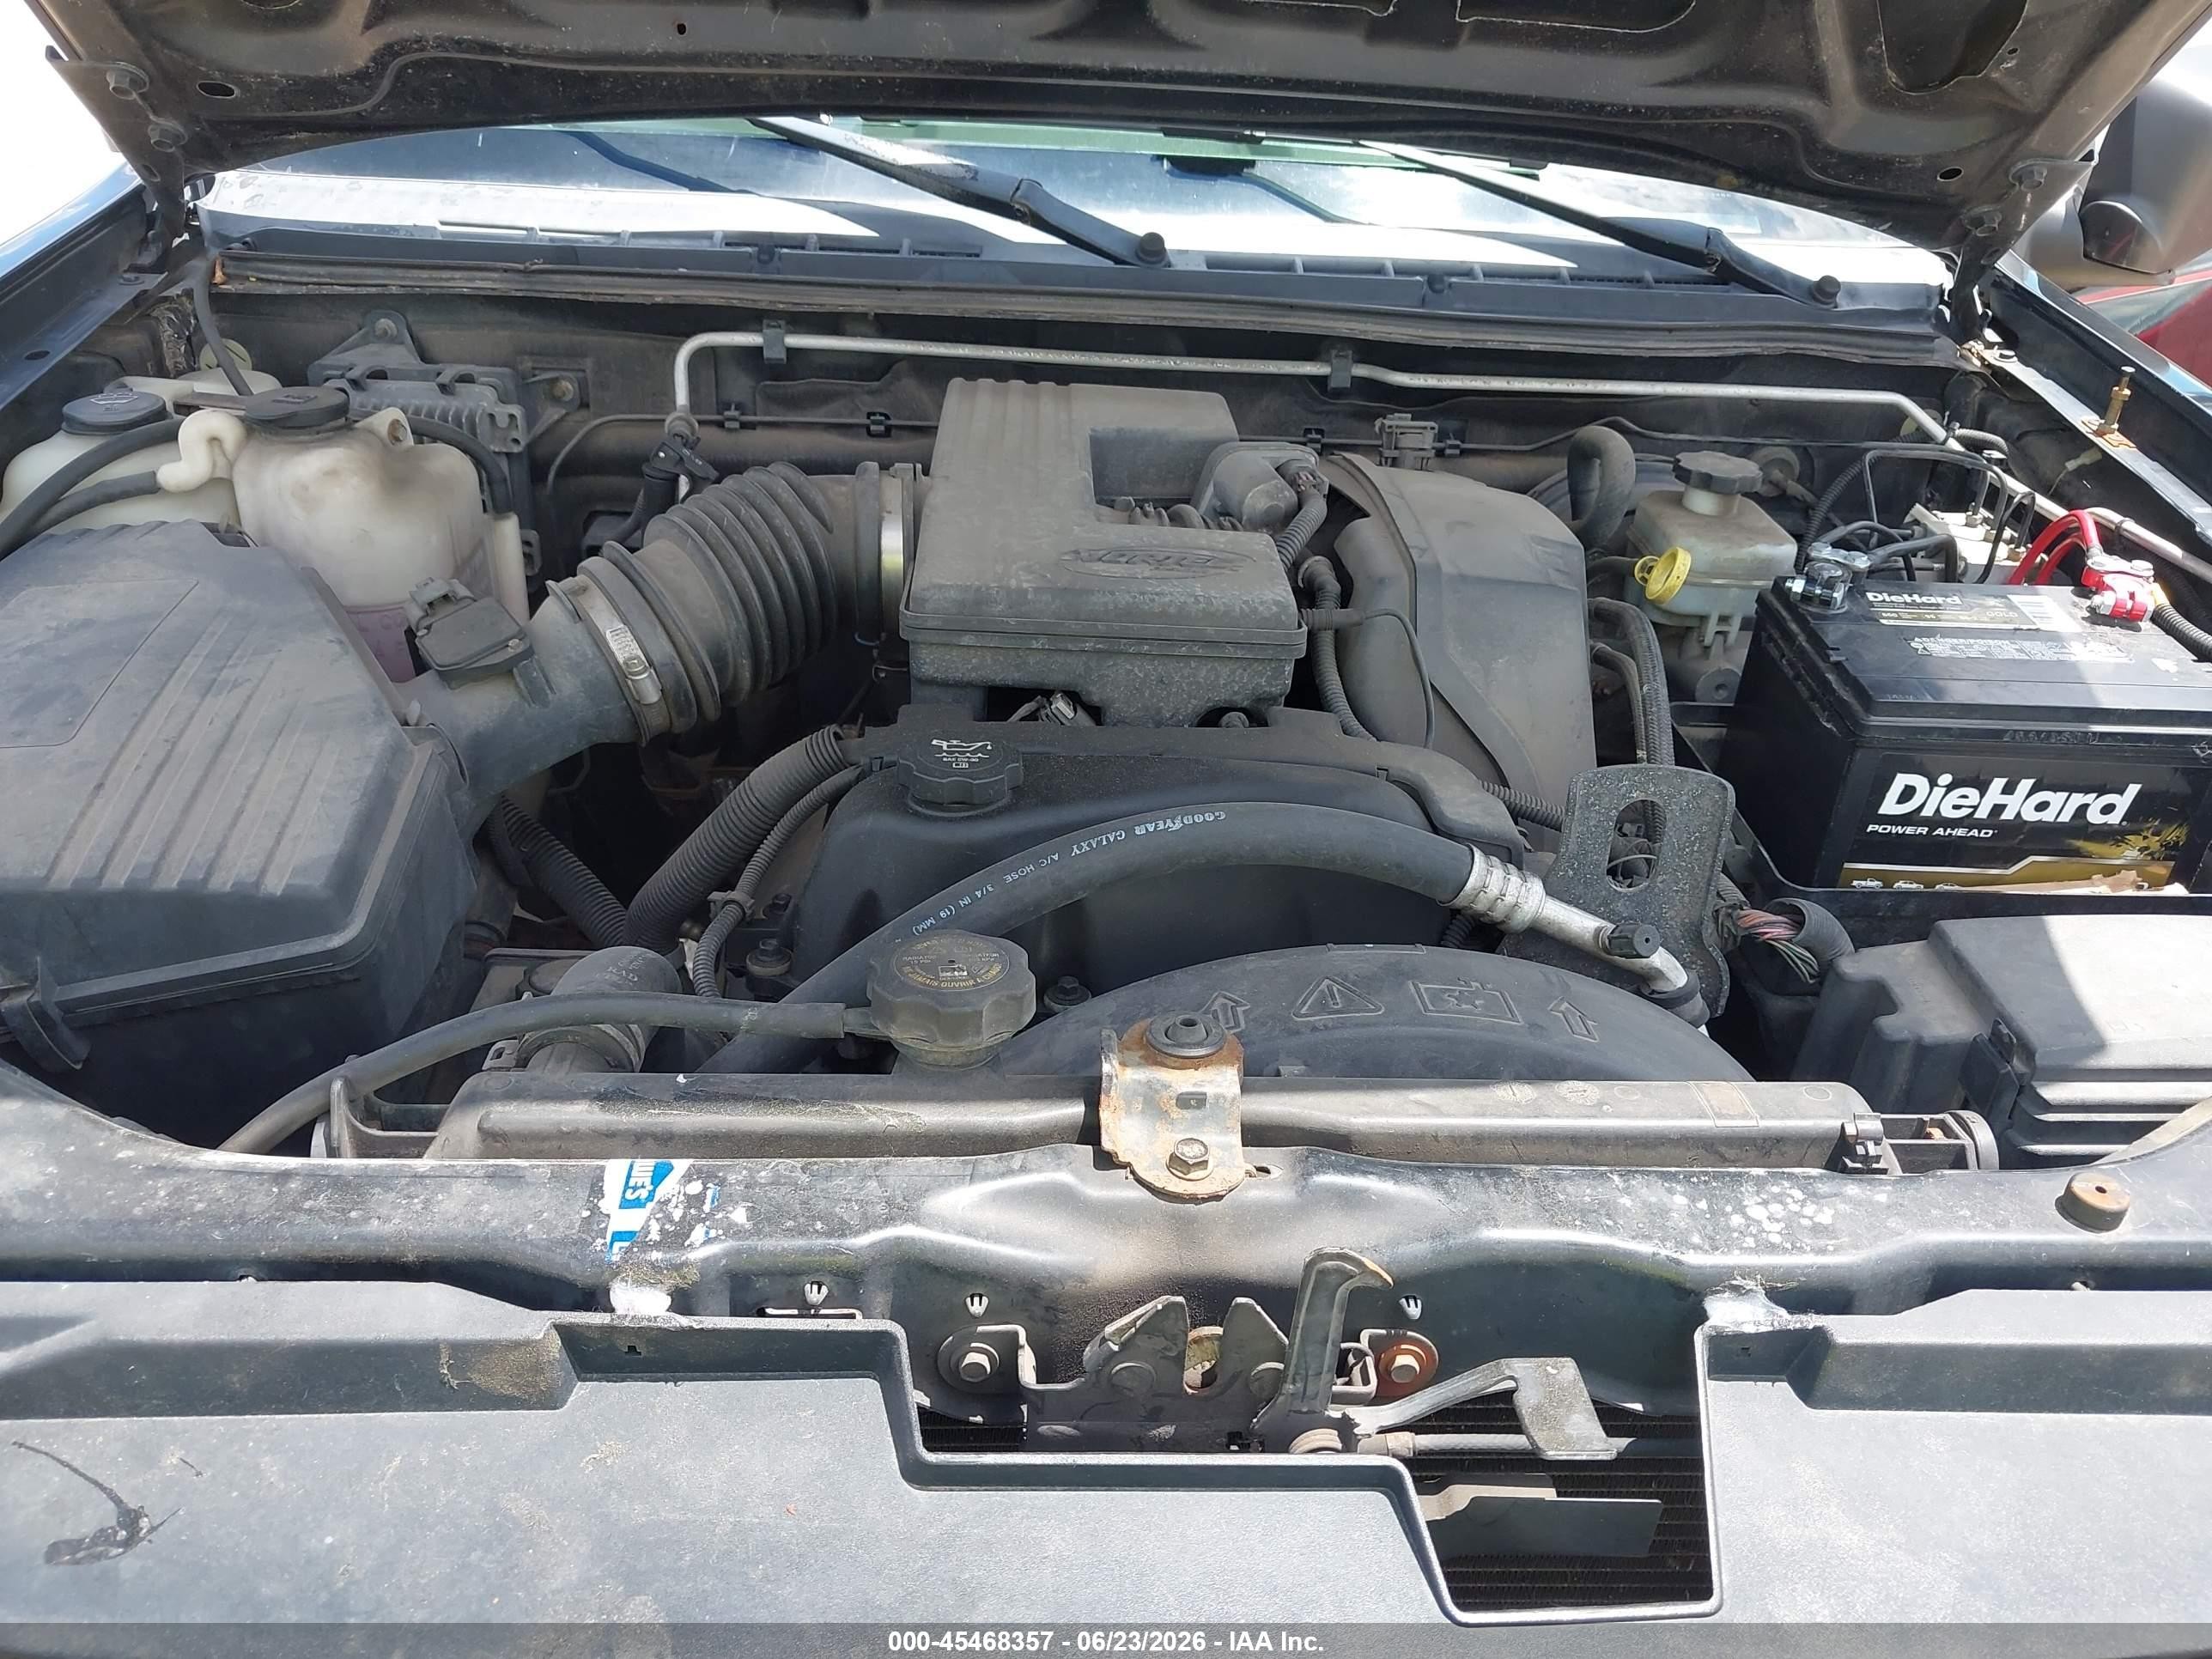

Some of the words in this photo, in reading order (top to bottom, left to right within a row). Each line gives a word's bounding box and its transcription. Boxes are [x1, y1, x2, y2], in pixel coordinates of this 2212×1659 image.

[1865, 592, 1963, 605] DieHard
[1878, 773, 2143, 826] DieHard
[1133, 811, 1227, 836] GOODYEAR
[1867, 823, 1928, 836] POWER
[1932, 826, 1998, 838] AHEAD
[1071, 830, 1127, 857] GALAXY
[1038, 852, 1060, 867] A/C
[1002, 864, 1036, 884] HOSE
[975, 884, 995, 899] 3/4
[957, 895, 972, 908] IN
[939, 904, 957, 920] (19
[912, 916, 937, 936] MM)
[940, 979, 976, 988] OUVRIR
